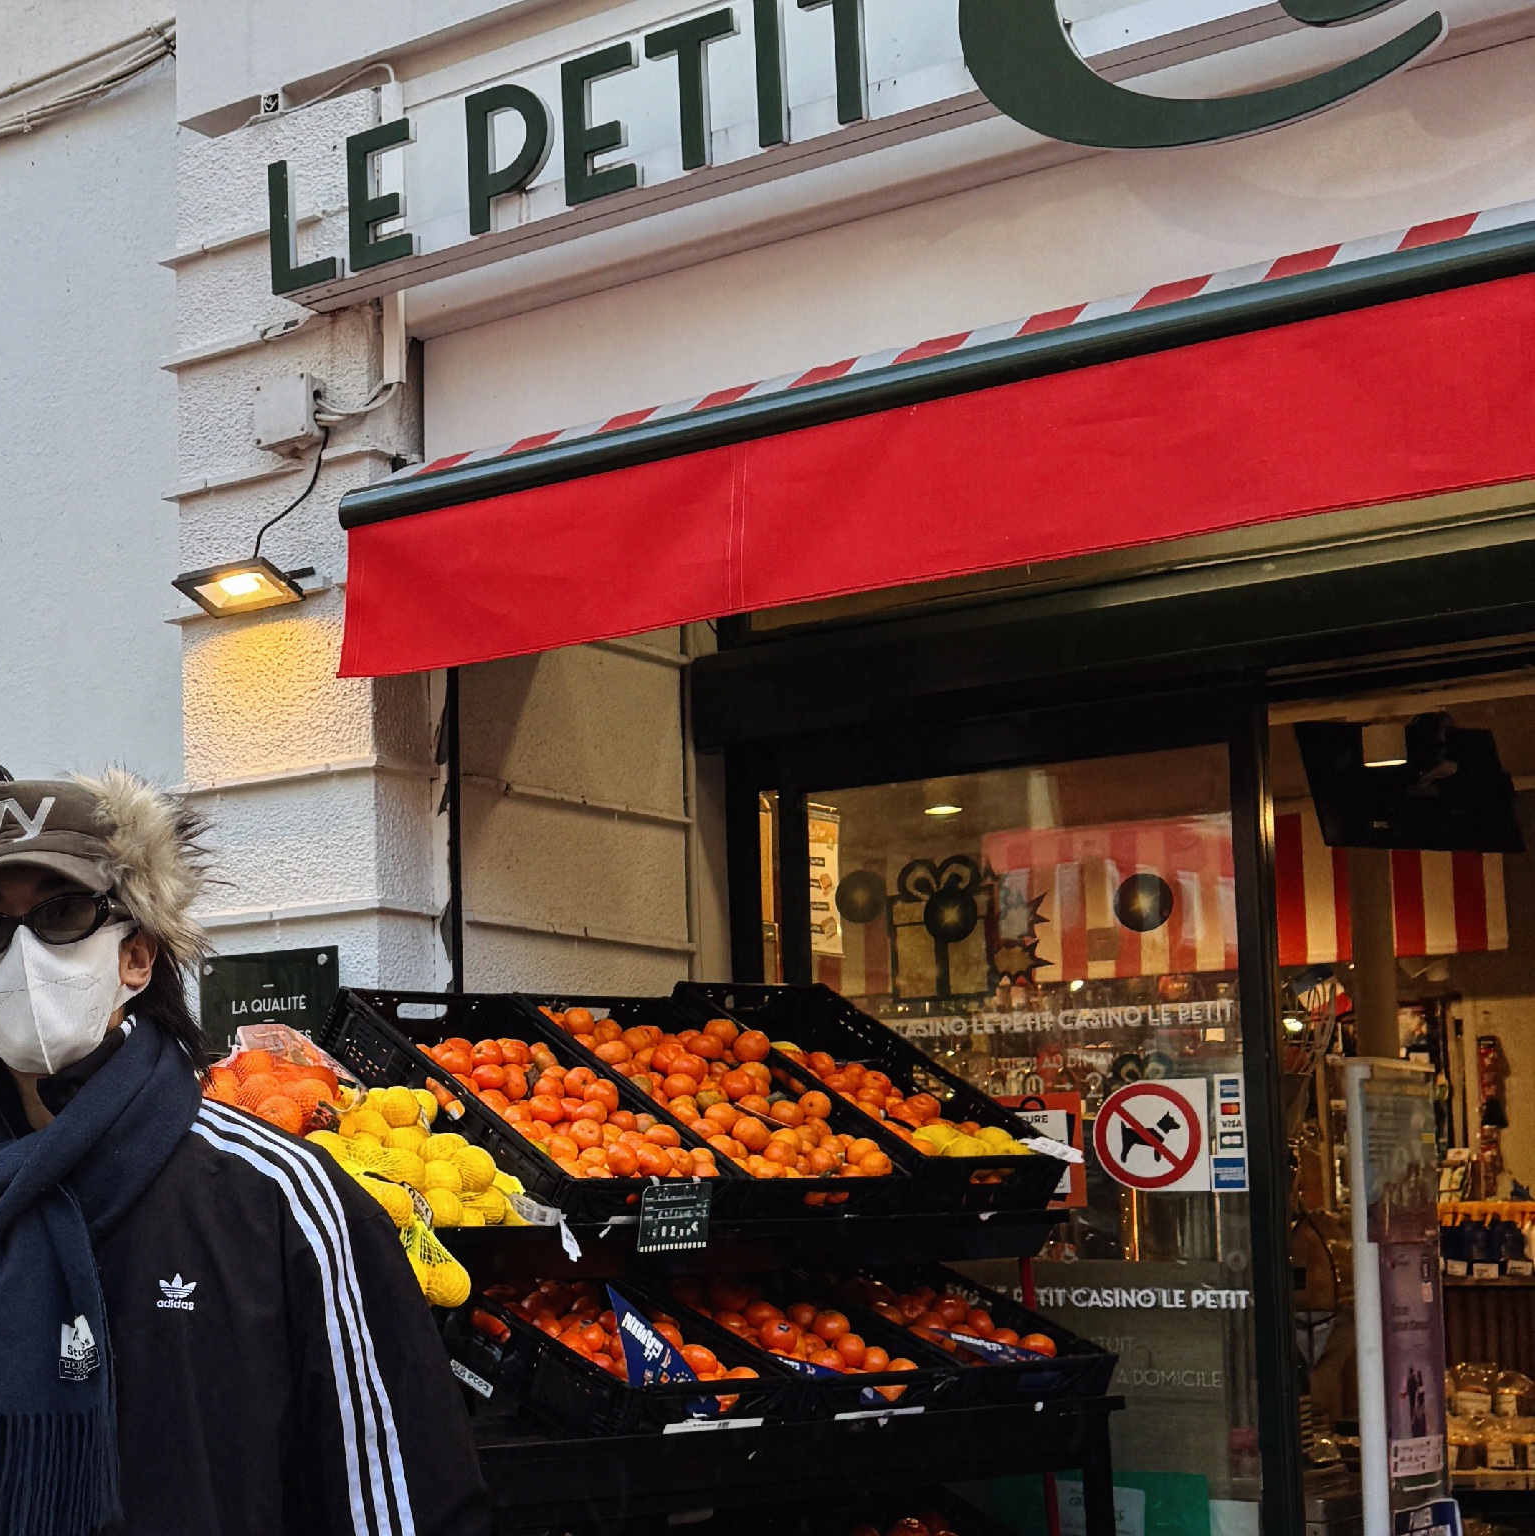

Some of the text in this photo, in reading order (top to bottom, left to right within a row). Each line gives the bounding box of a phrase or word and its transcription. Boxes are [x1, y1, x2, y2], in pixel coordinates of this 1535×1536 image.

[268, 118, 415, 296] LE
[466, 0, 868, 237] PETIT
[232, 994, 307, 1015] LA QUALITÉ
[1057, 1005, 1142, 1031] CASINO
[1147, 1005, 1171, 1024] LE
[1177, 999, 1235, 1023] PETIT
[1220, 1119, 1243, 1129] VISA
[157, 1299, 195, 1310] adidas
[1073, 1289, 1156, 1309] CASINO
[1164, 1290, 1186, 1308] LE
[1191, 1289, 1250, 1309] PETIT
[1133, 1369, 1224, 1389] DOMICILE
